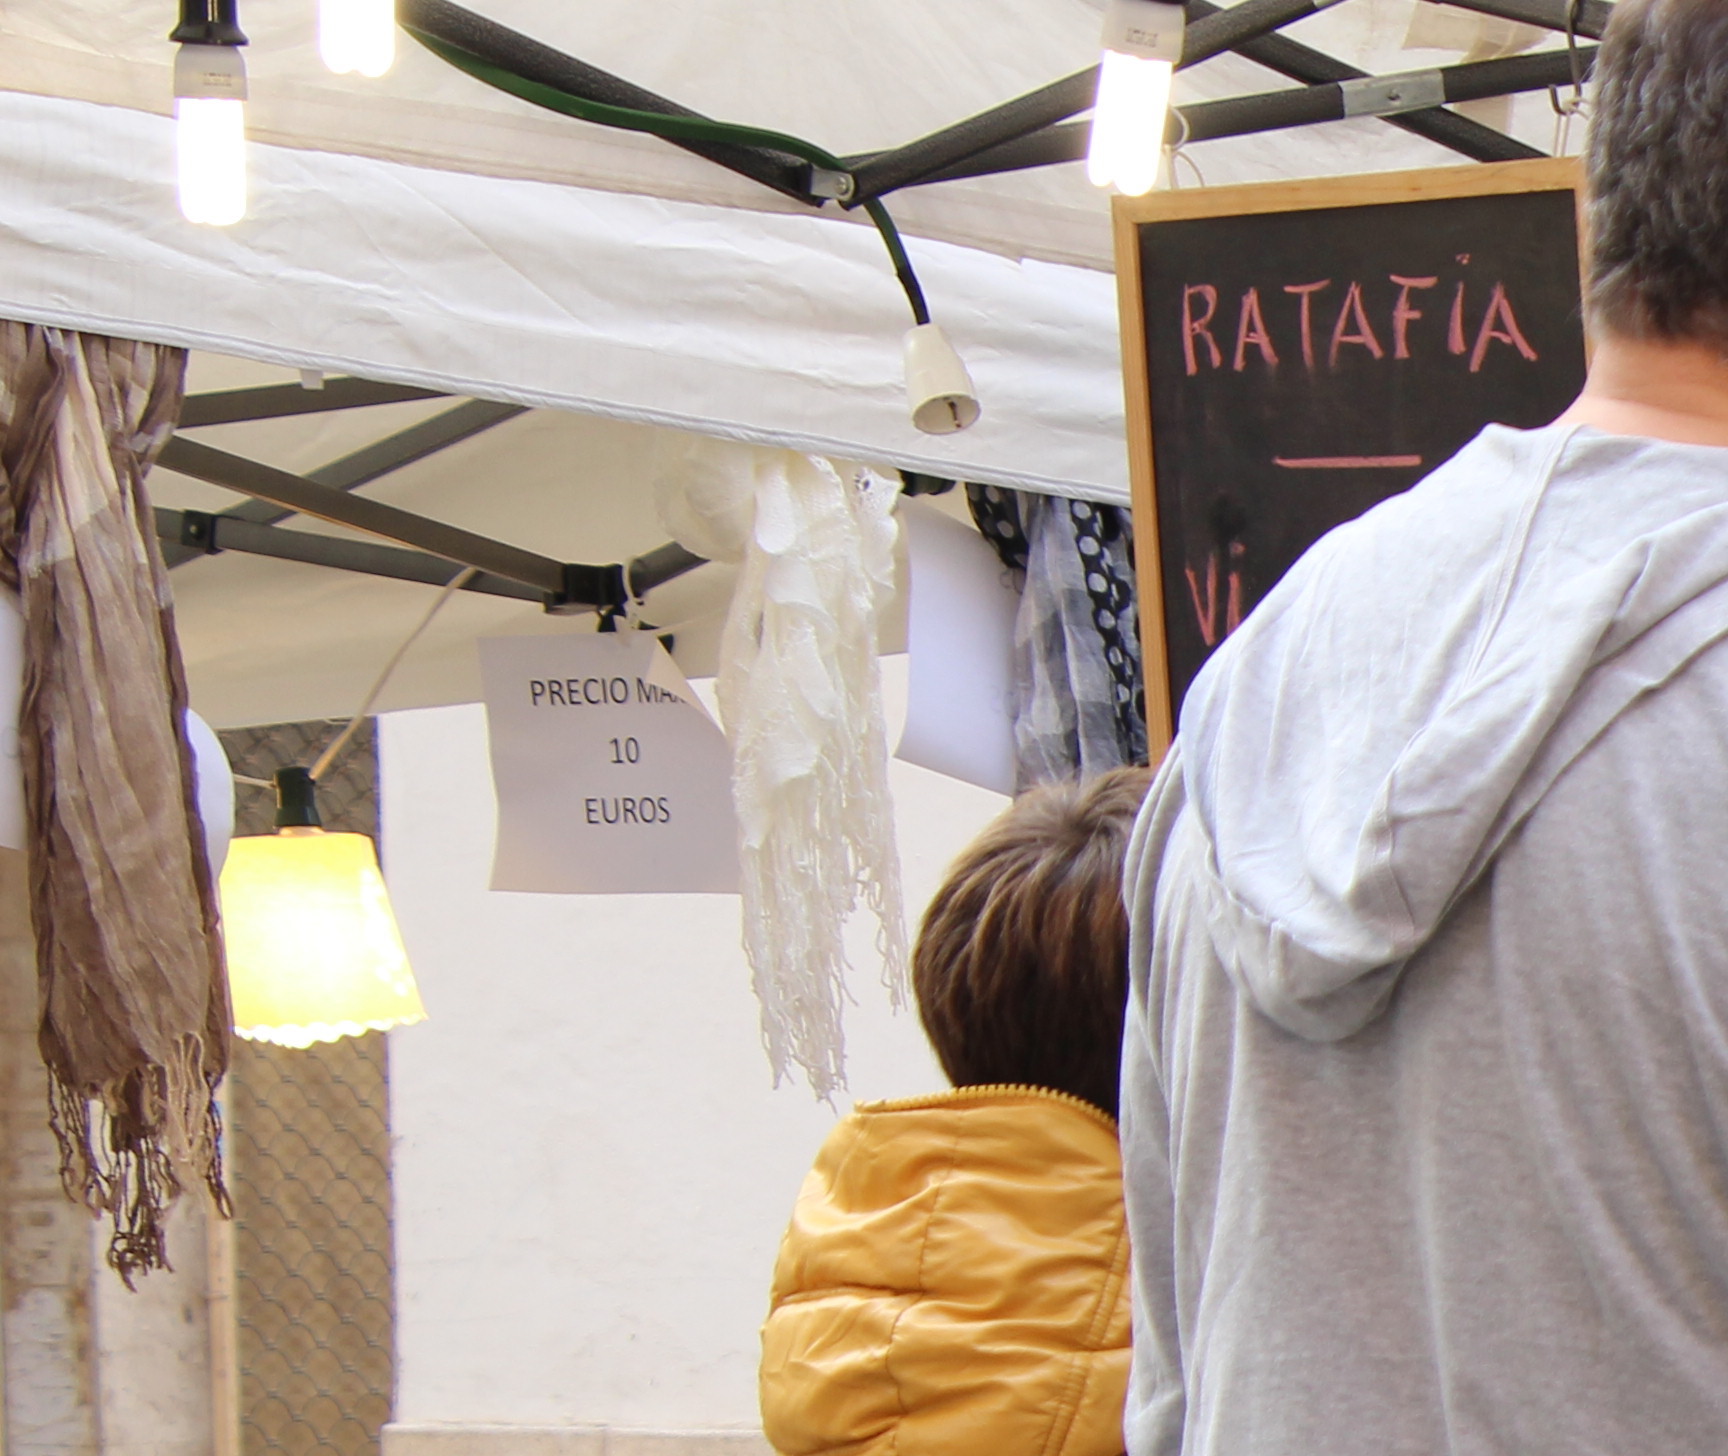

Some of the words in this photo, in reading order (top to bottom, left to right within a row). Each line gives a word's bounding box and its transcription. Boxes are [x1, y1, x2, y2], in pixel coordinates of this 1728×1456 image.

[529, 676, 629, 707] PRECIO
[608, 736, 641, 764] 10
[584, 796, 671, 825] EUROS
